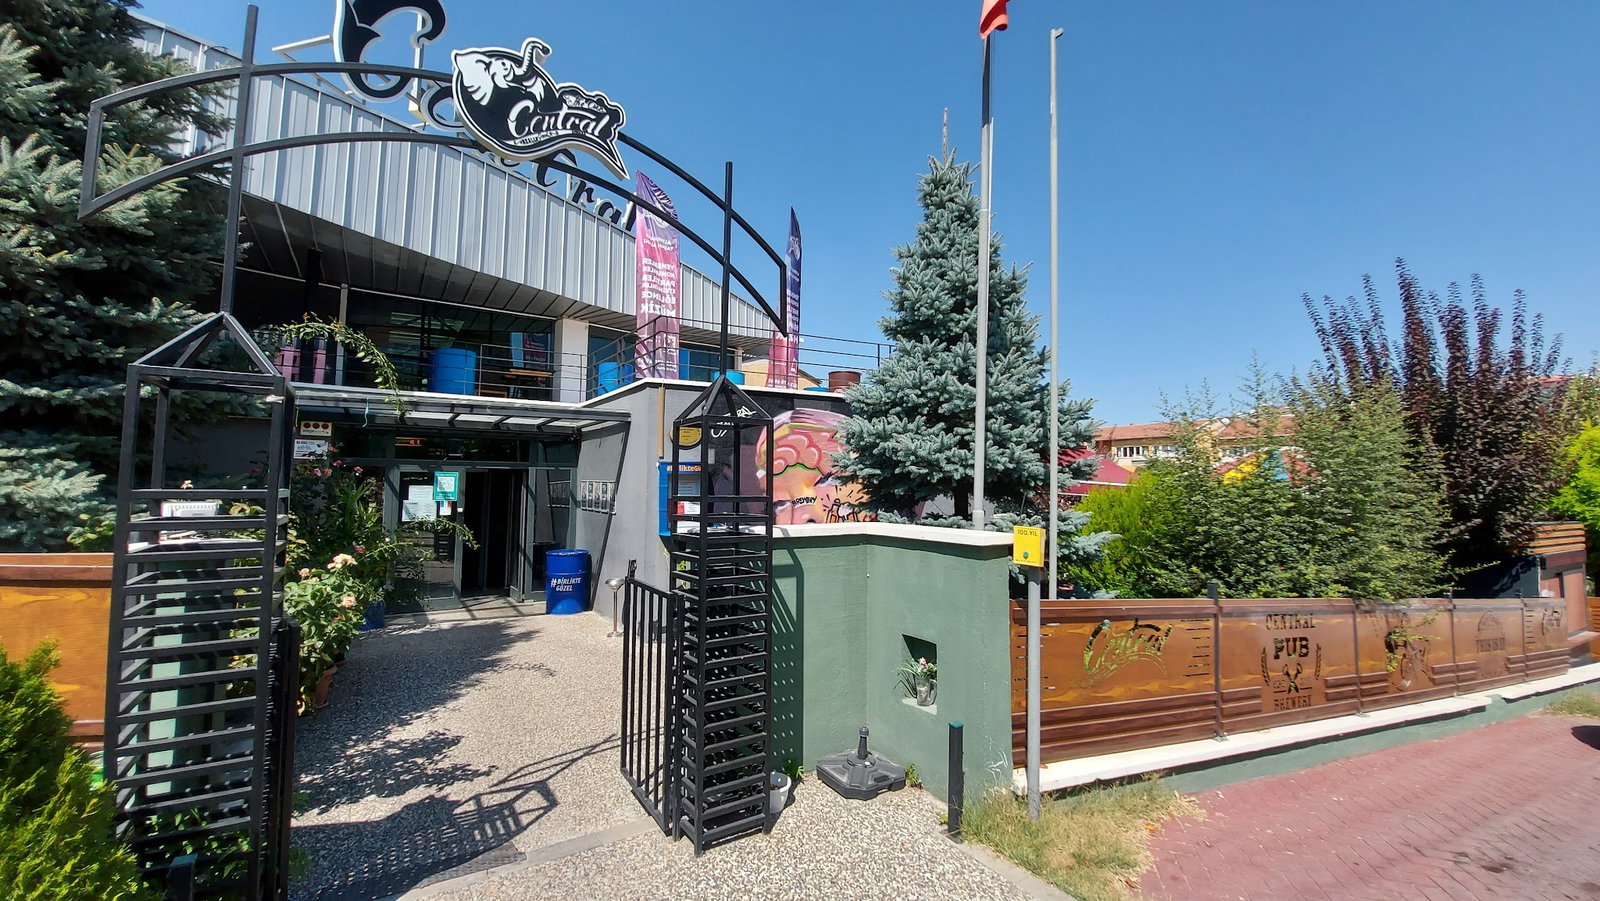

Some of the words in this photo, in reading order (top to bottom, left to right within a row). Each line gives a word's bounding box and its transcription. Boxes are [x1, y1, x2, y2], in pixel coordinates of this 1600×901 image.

[507, 100, 610, 138] Central
[1265, 613, 1316, 631] CENTRAL
[1273, 636, 1310, 660] PUB
